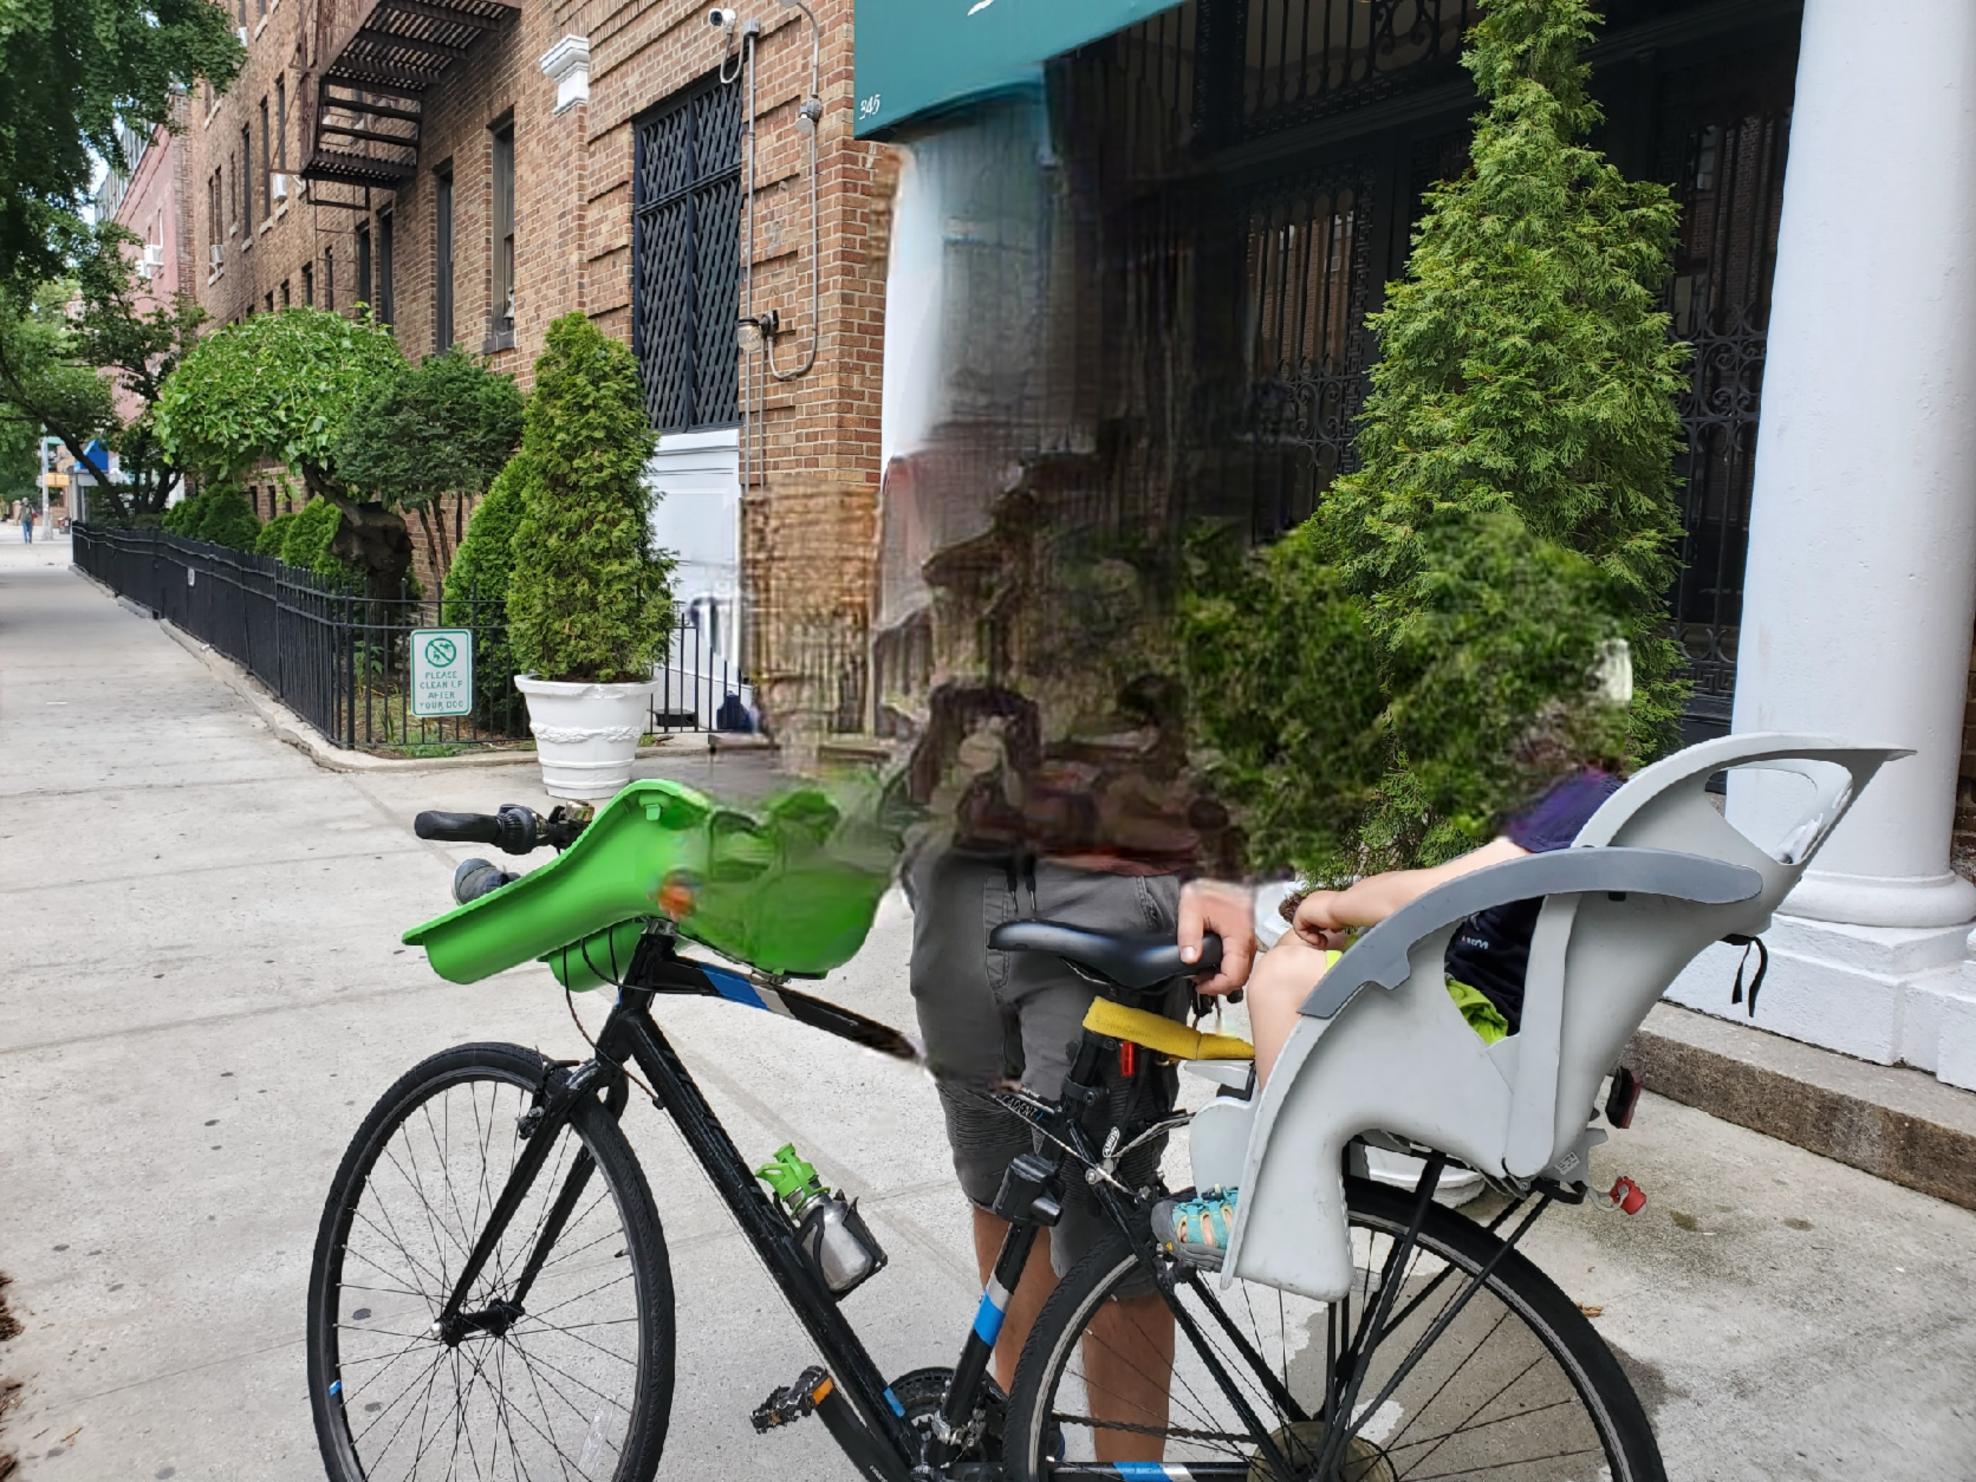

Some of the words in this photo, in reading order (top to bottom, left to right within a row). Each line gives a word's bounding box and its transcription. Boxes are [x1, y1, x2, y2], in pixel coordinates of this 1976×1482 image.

[858, 94, 881, 120] 345
[425, 670, 458, 679] PLEASE
[419, 681, 448, 690] CLEAN
[427, 691, 455, 699] AFTER
[419, 701, 443, 710] YOUR
